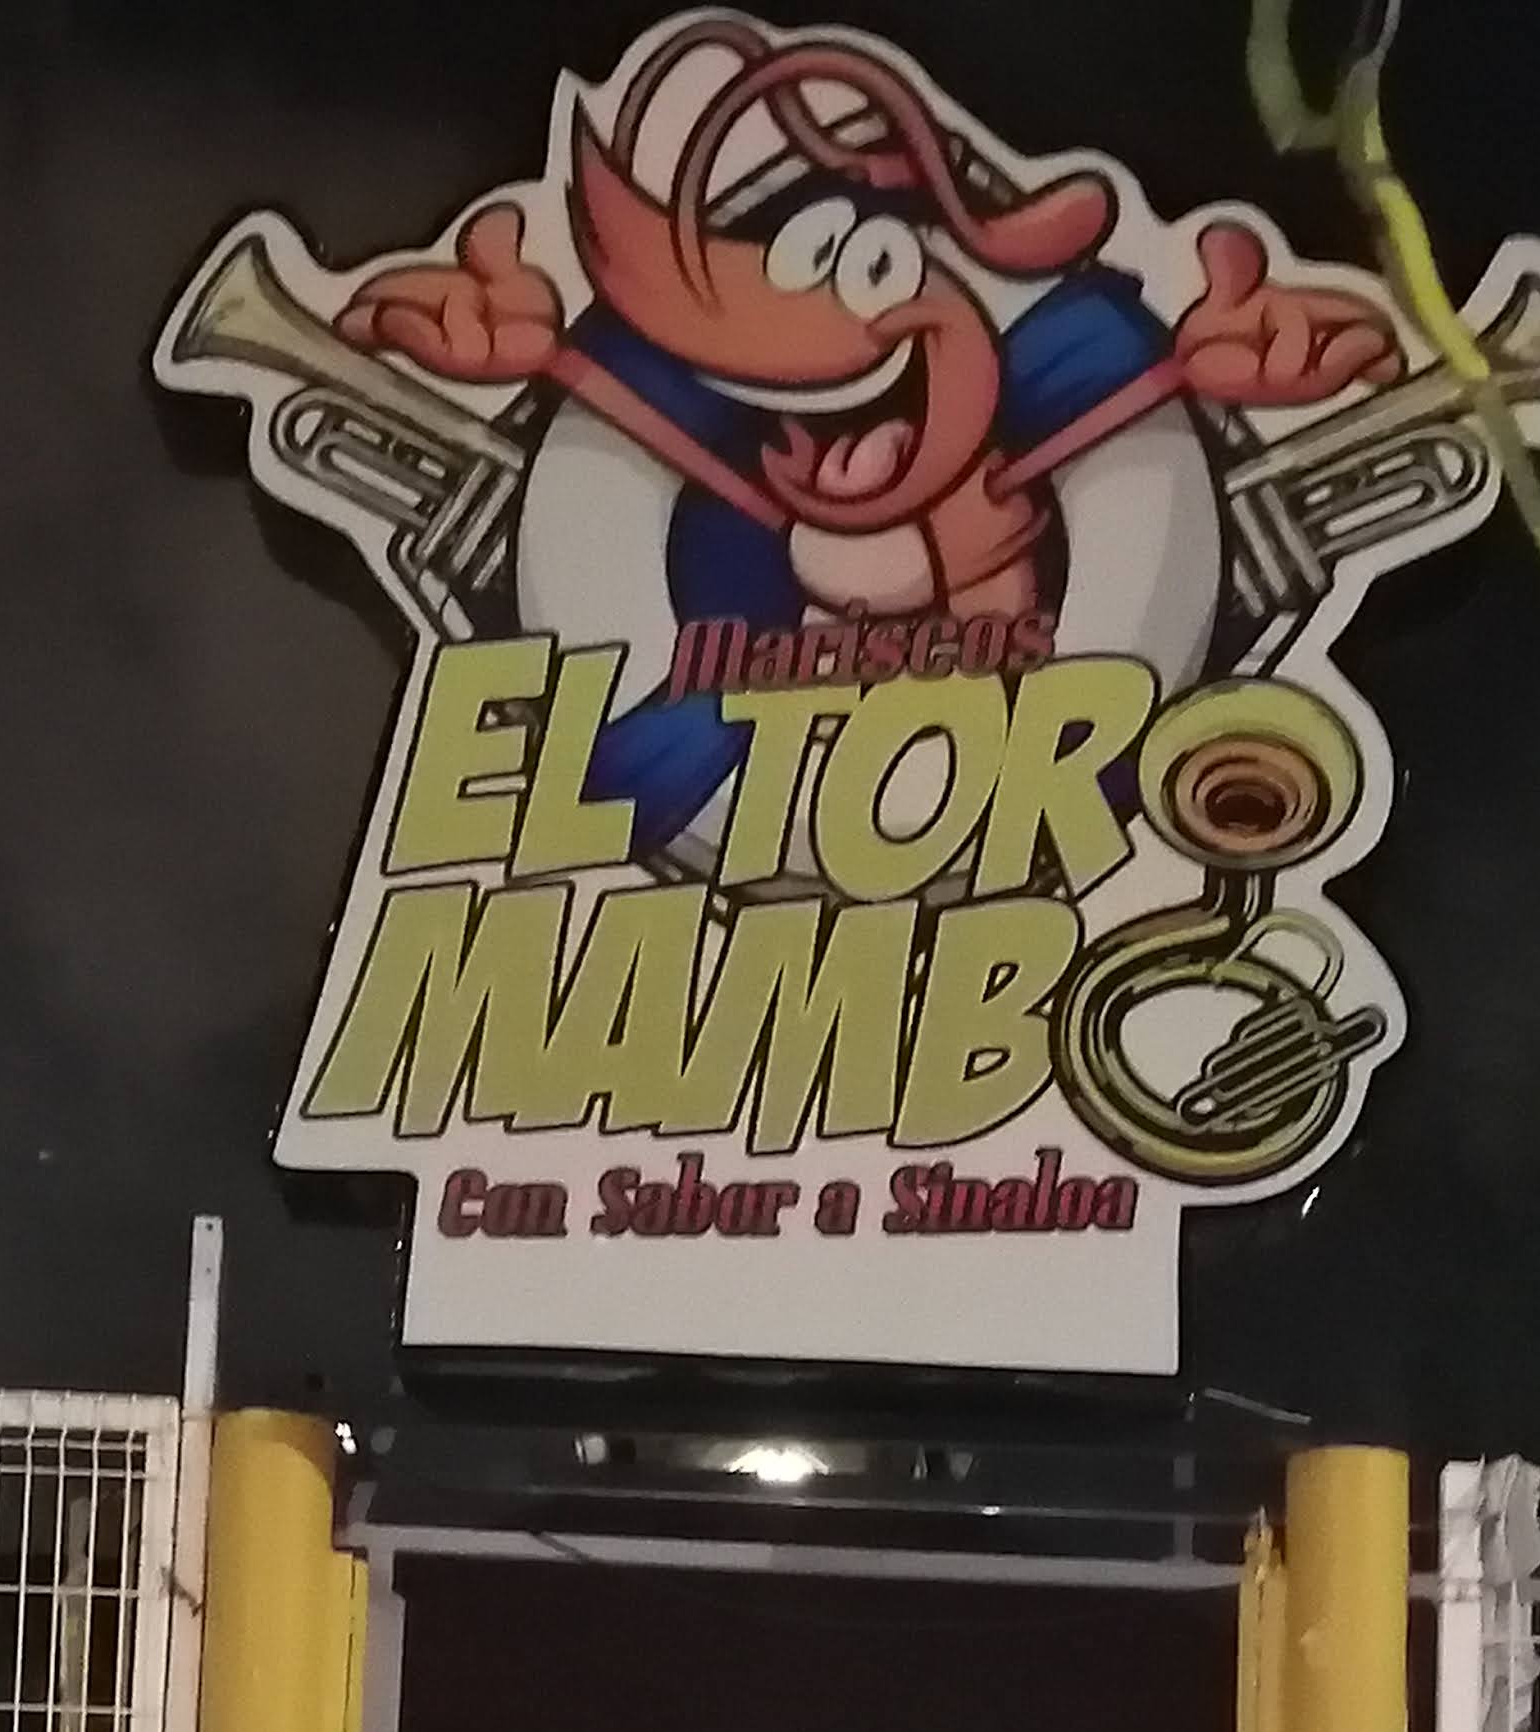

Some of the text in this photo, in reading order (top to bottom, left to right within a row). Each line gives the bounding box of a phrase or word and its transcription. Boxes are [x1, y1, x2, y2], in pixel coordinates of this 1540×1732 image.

[664, 612, 1056, 705] Mariscos
[386, 632, 635, 878] EL
[437, 1146, 1140, 1238] Con Sabor a Sinaloa
